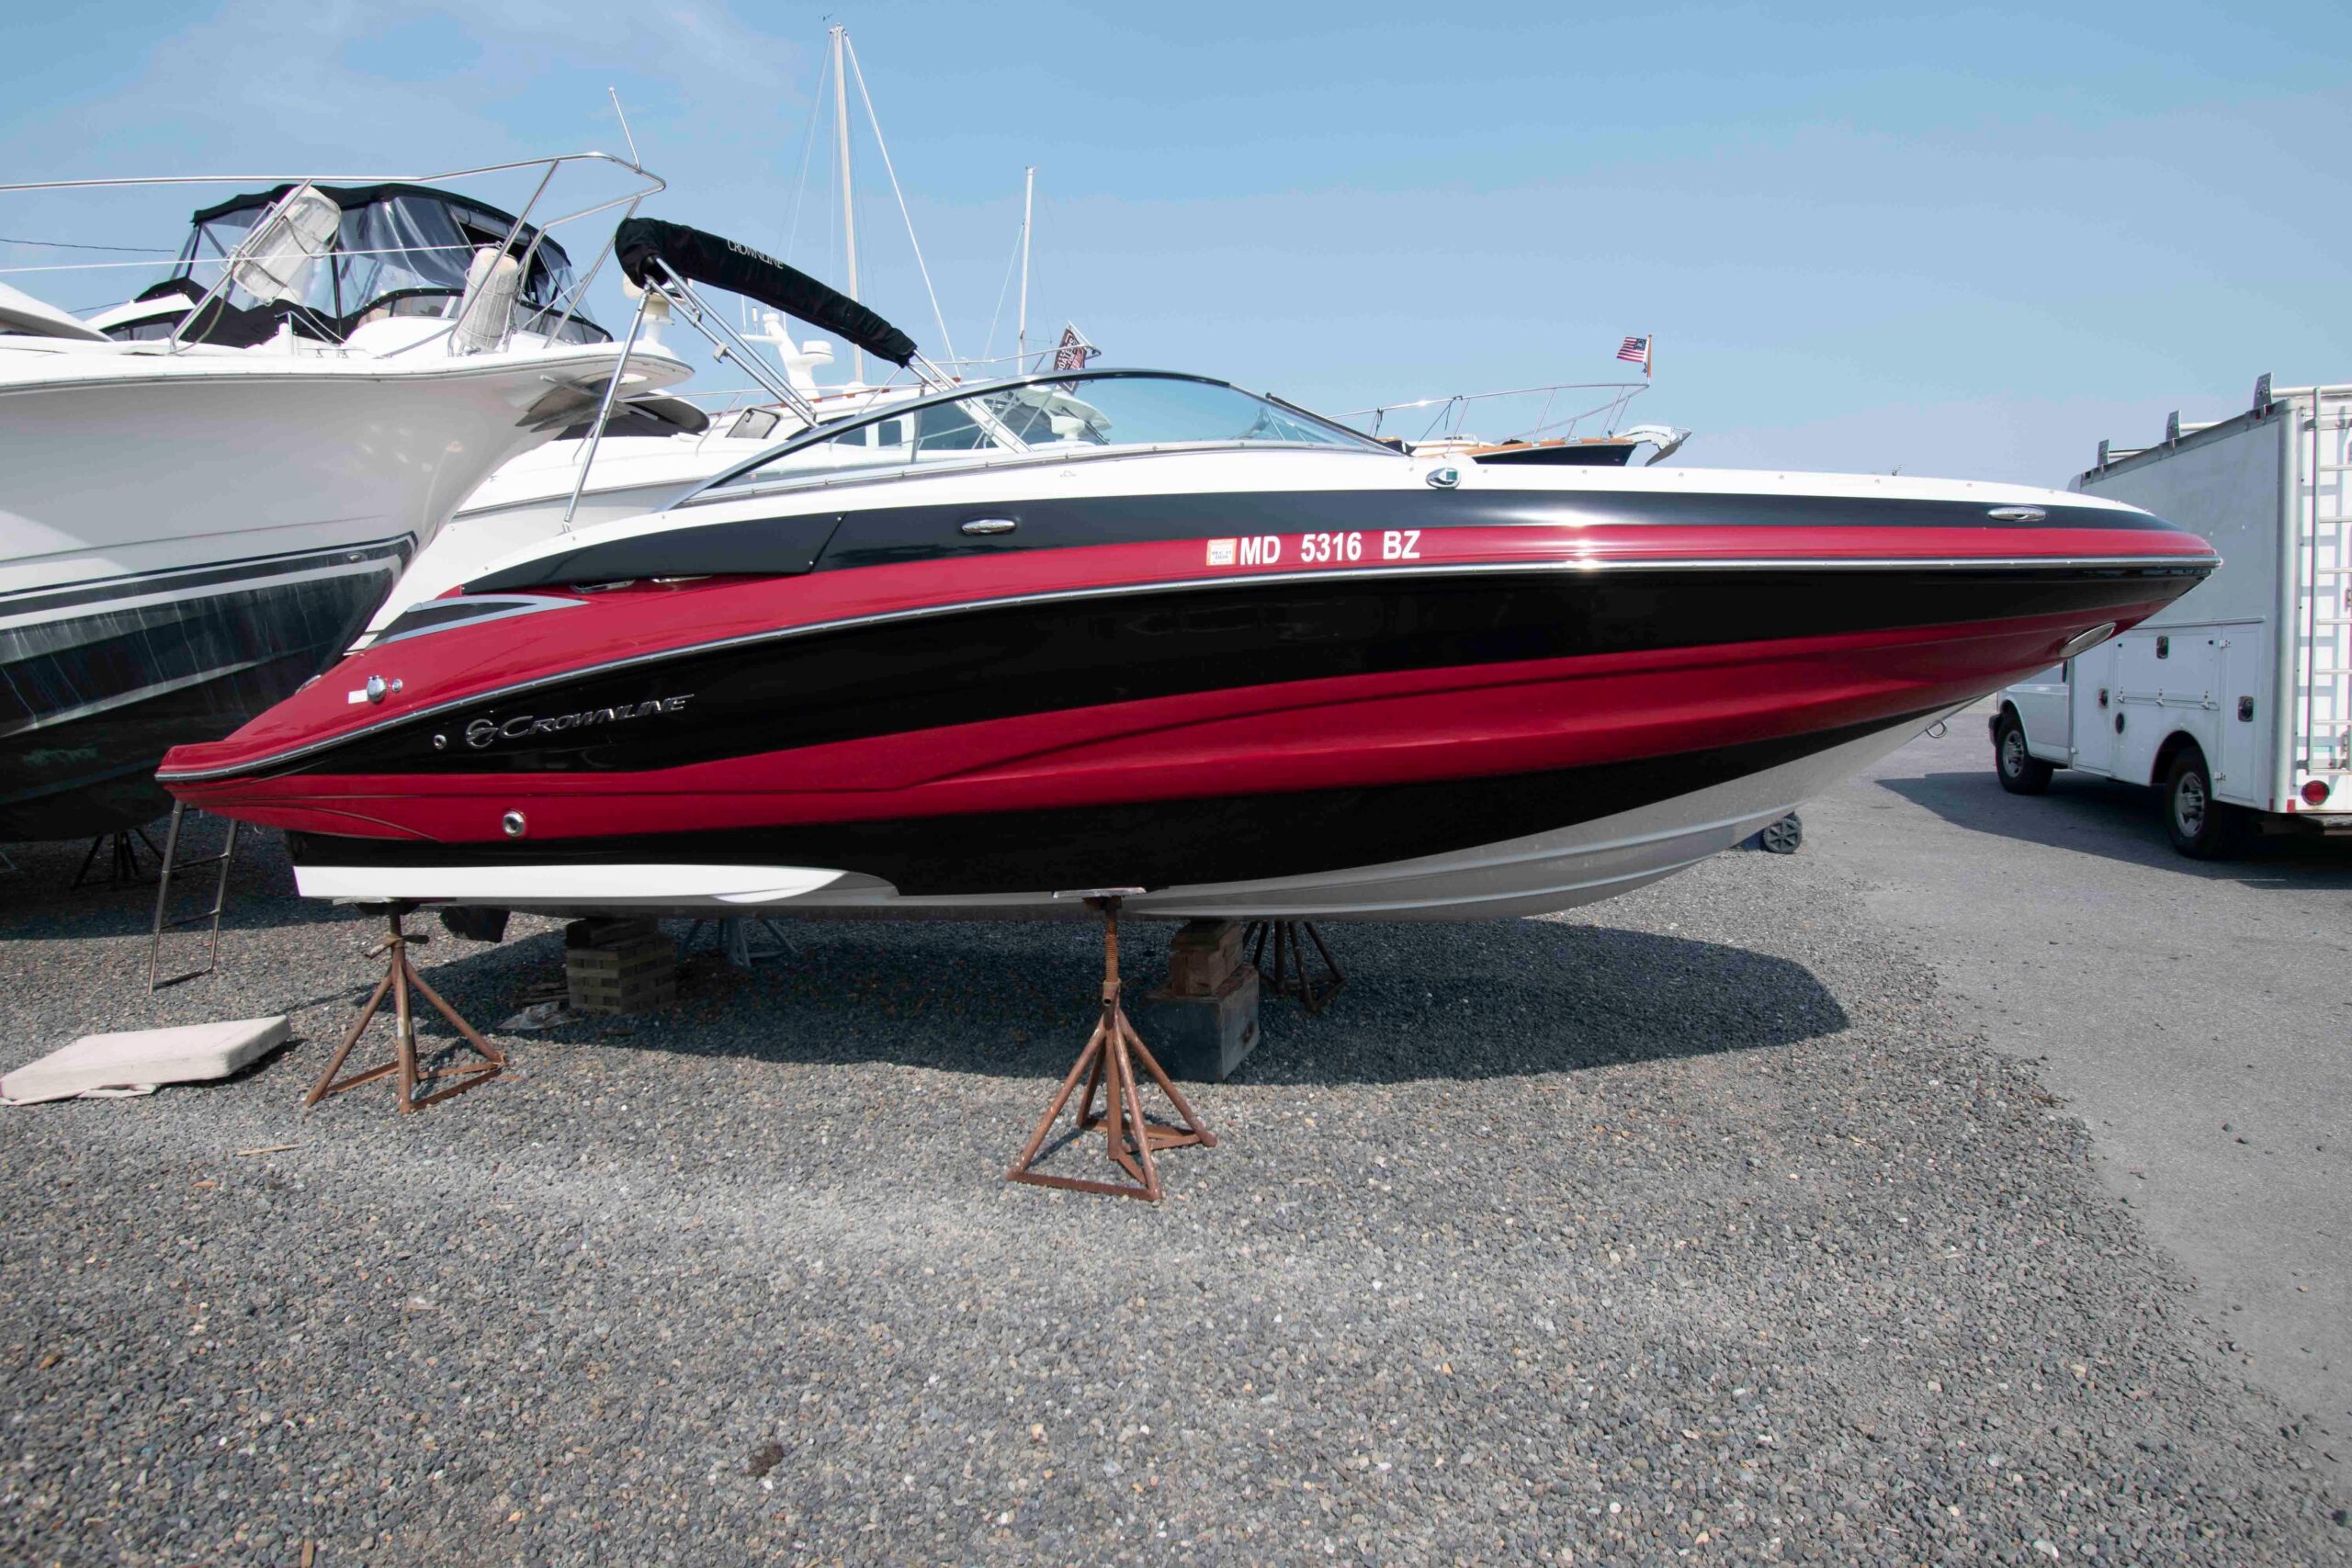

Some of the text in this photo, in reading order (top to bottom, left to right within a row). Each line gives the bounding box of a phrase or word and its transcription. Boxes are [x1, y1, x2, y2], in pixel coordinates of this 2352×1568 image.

[1240, 530, 1420, 565] MD 5316 BZ
[499, 694, 695, 739] CROWNLINE
